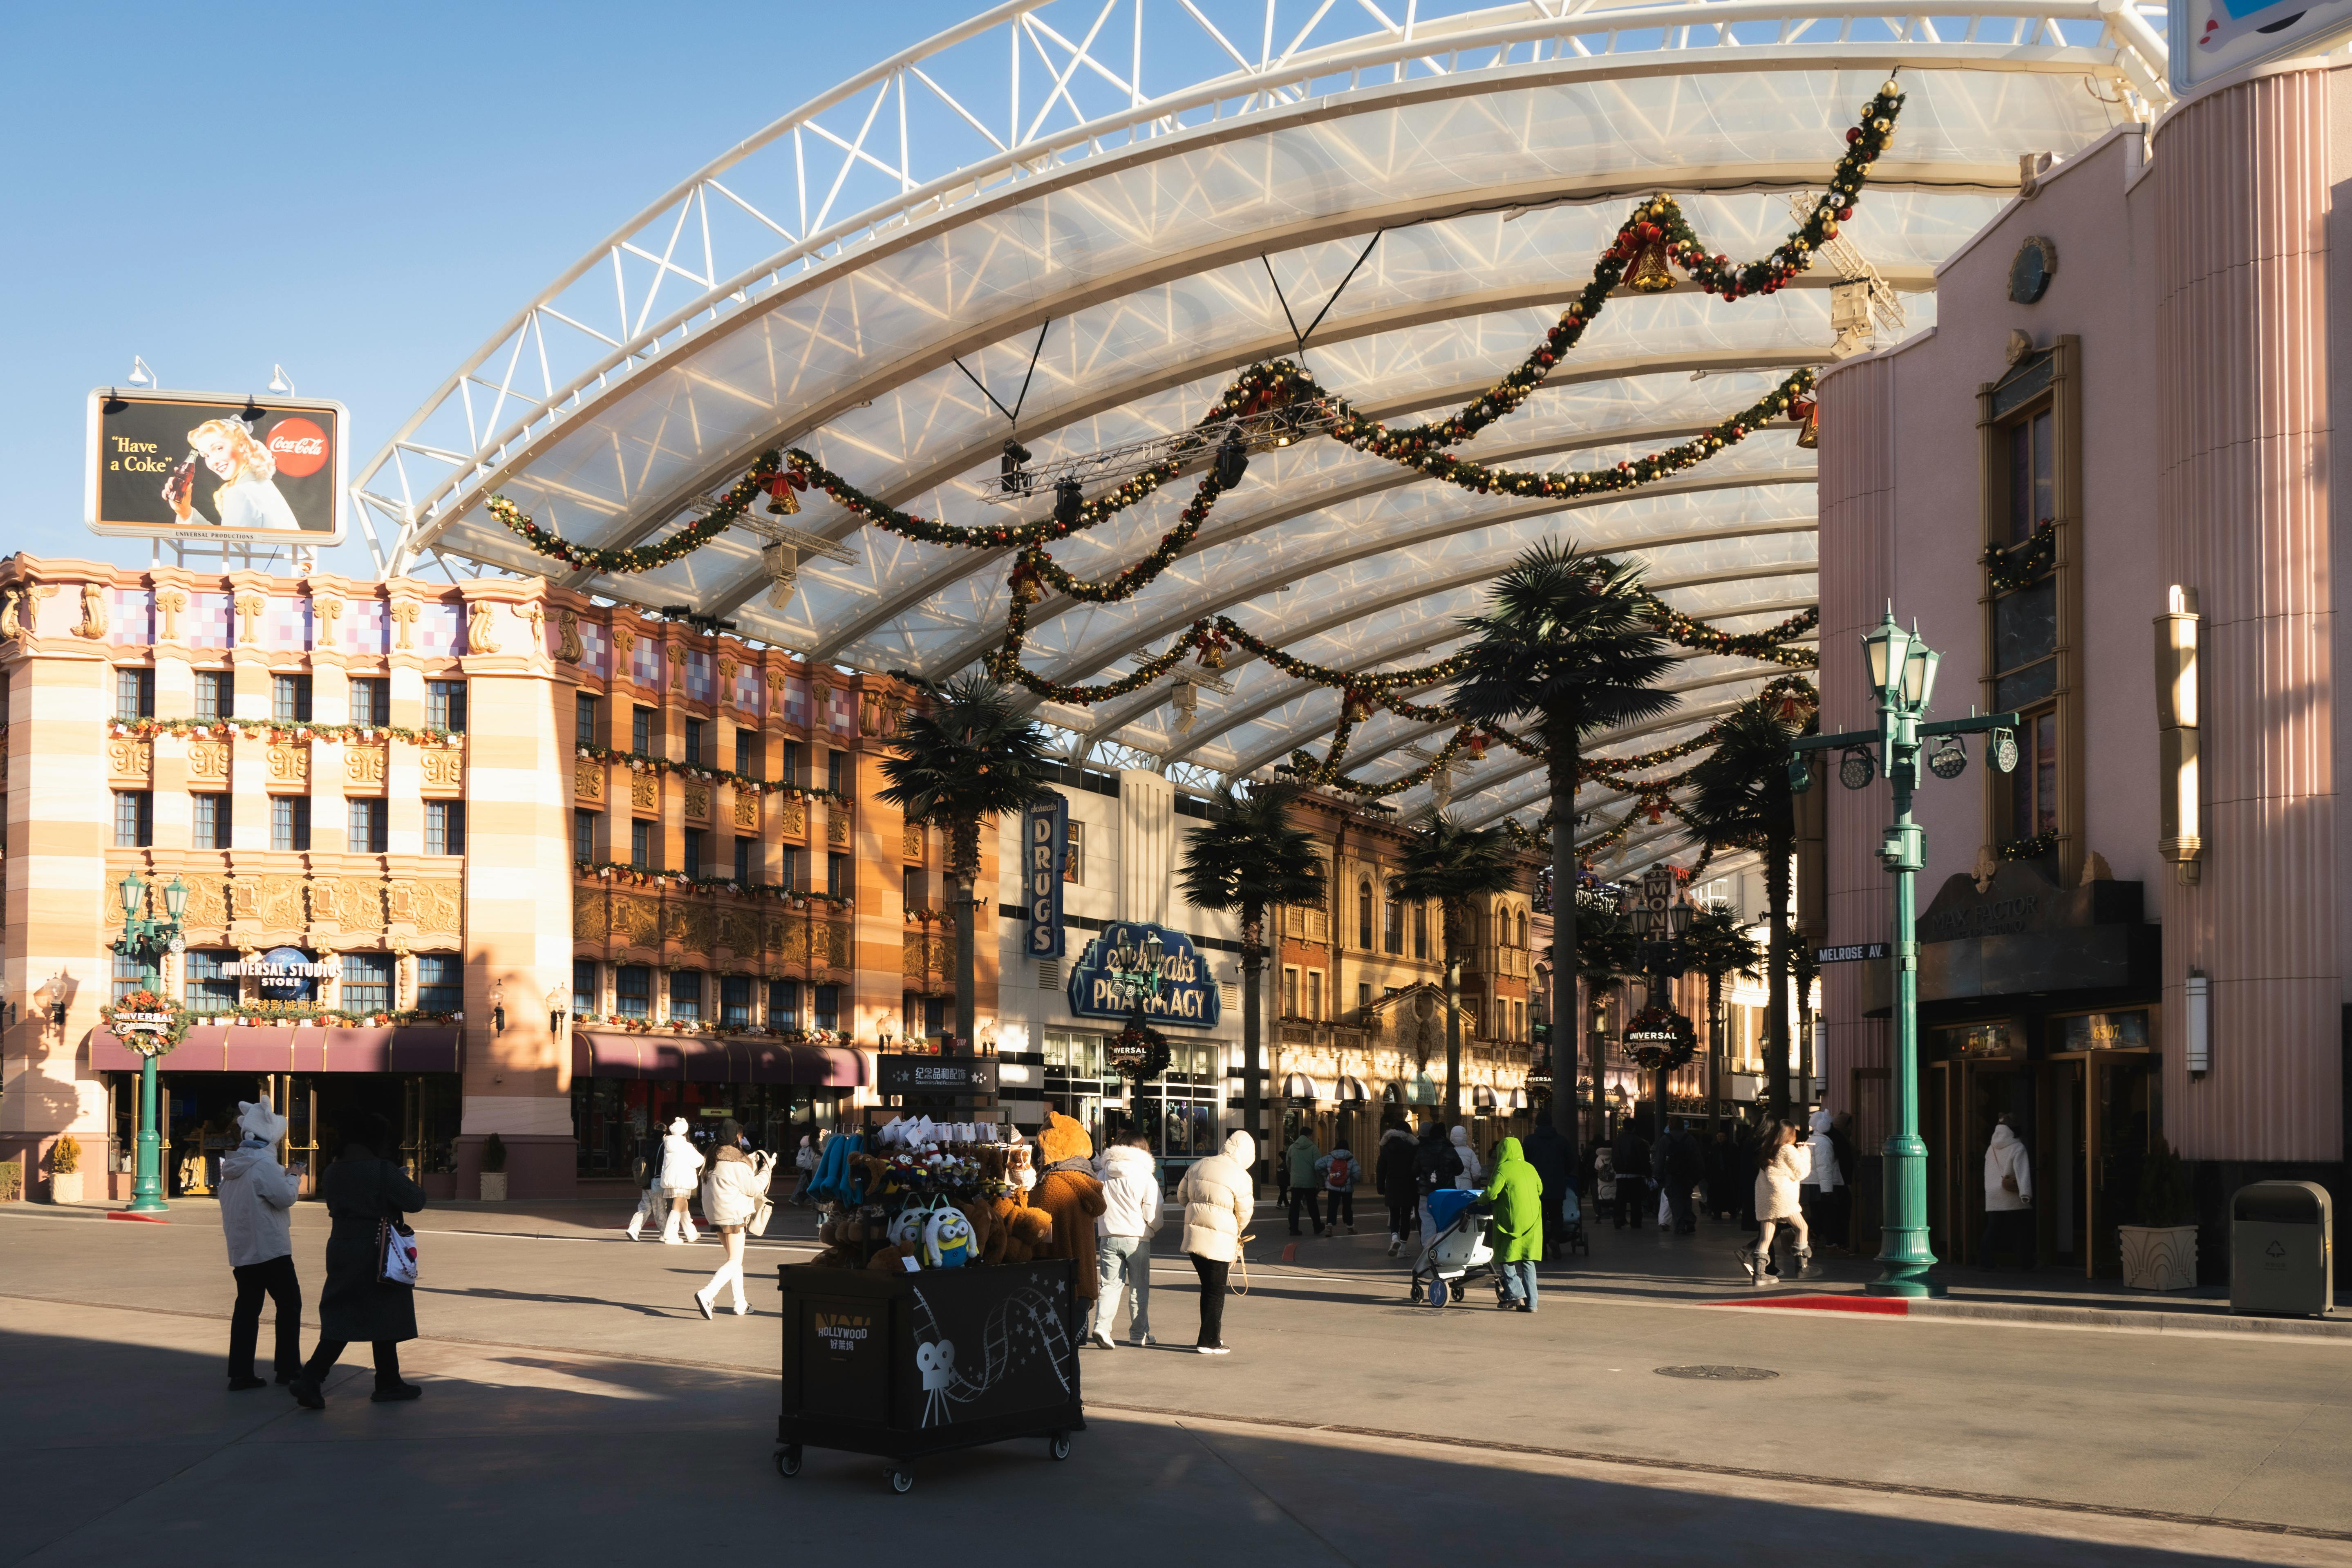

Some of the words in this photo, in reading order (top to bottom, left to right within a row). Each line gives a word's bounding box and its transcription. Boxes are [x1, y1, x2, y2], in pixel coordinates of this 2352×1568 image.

[270, 436, 324, 455] Coca-Cola
[110, 461, 120, 470] a
[1030, 802, 1057, 813] Schwab's
[1034, 819, 1051, 950] DRUGS
[1932, 910, 1969, 931] MAX
[1975, 895, 2038, 923] FACTOR
[1819, 946, 1863, 961] MELROSE
[1869, 945, 1883, 957] AV.
[222, 962, 286, 976] UNIVERSAL
[289, 963, 344, 978] STUDIOS
[262, 978, 300, 986] STORE
[244, 1000, 322, 1012] 环球影城商店
[117, 1013, 174, 1021] UNIVERSAL
[2093, 1024, 2119, 1040] 6507
[915, 1067, 966, 1079] 纪念品和配饰
[819, 1327, 867, 1339] HOLLYWOOD
[830, 1339, 854, 1351] 好莱坞
